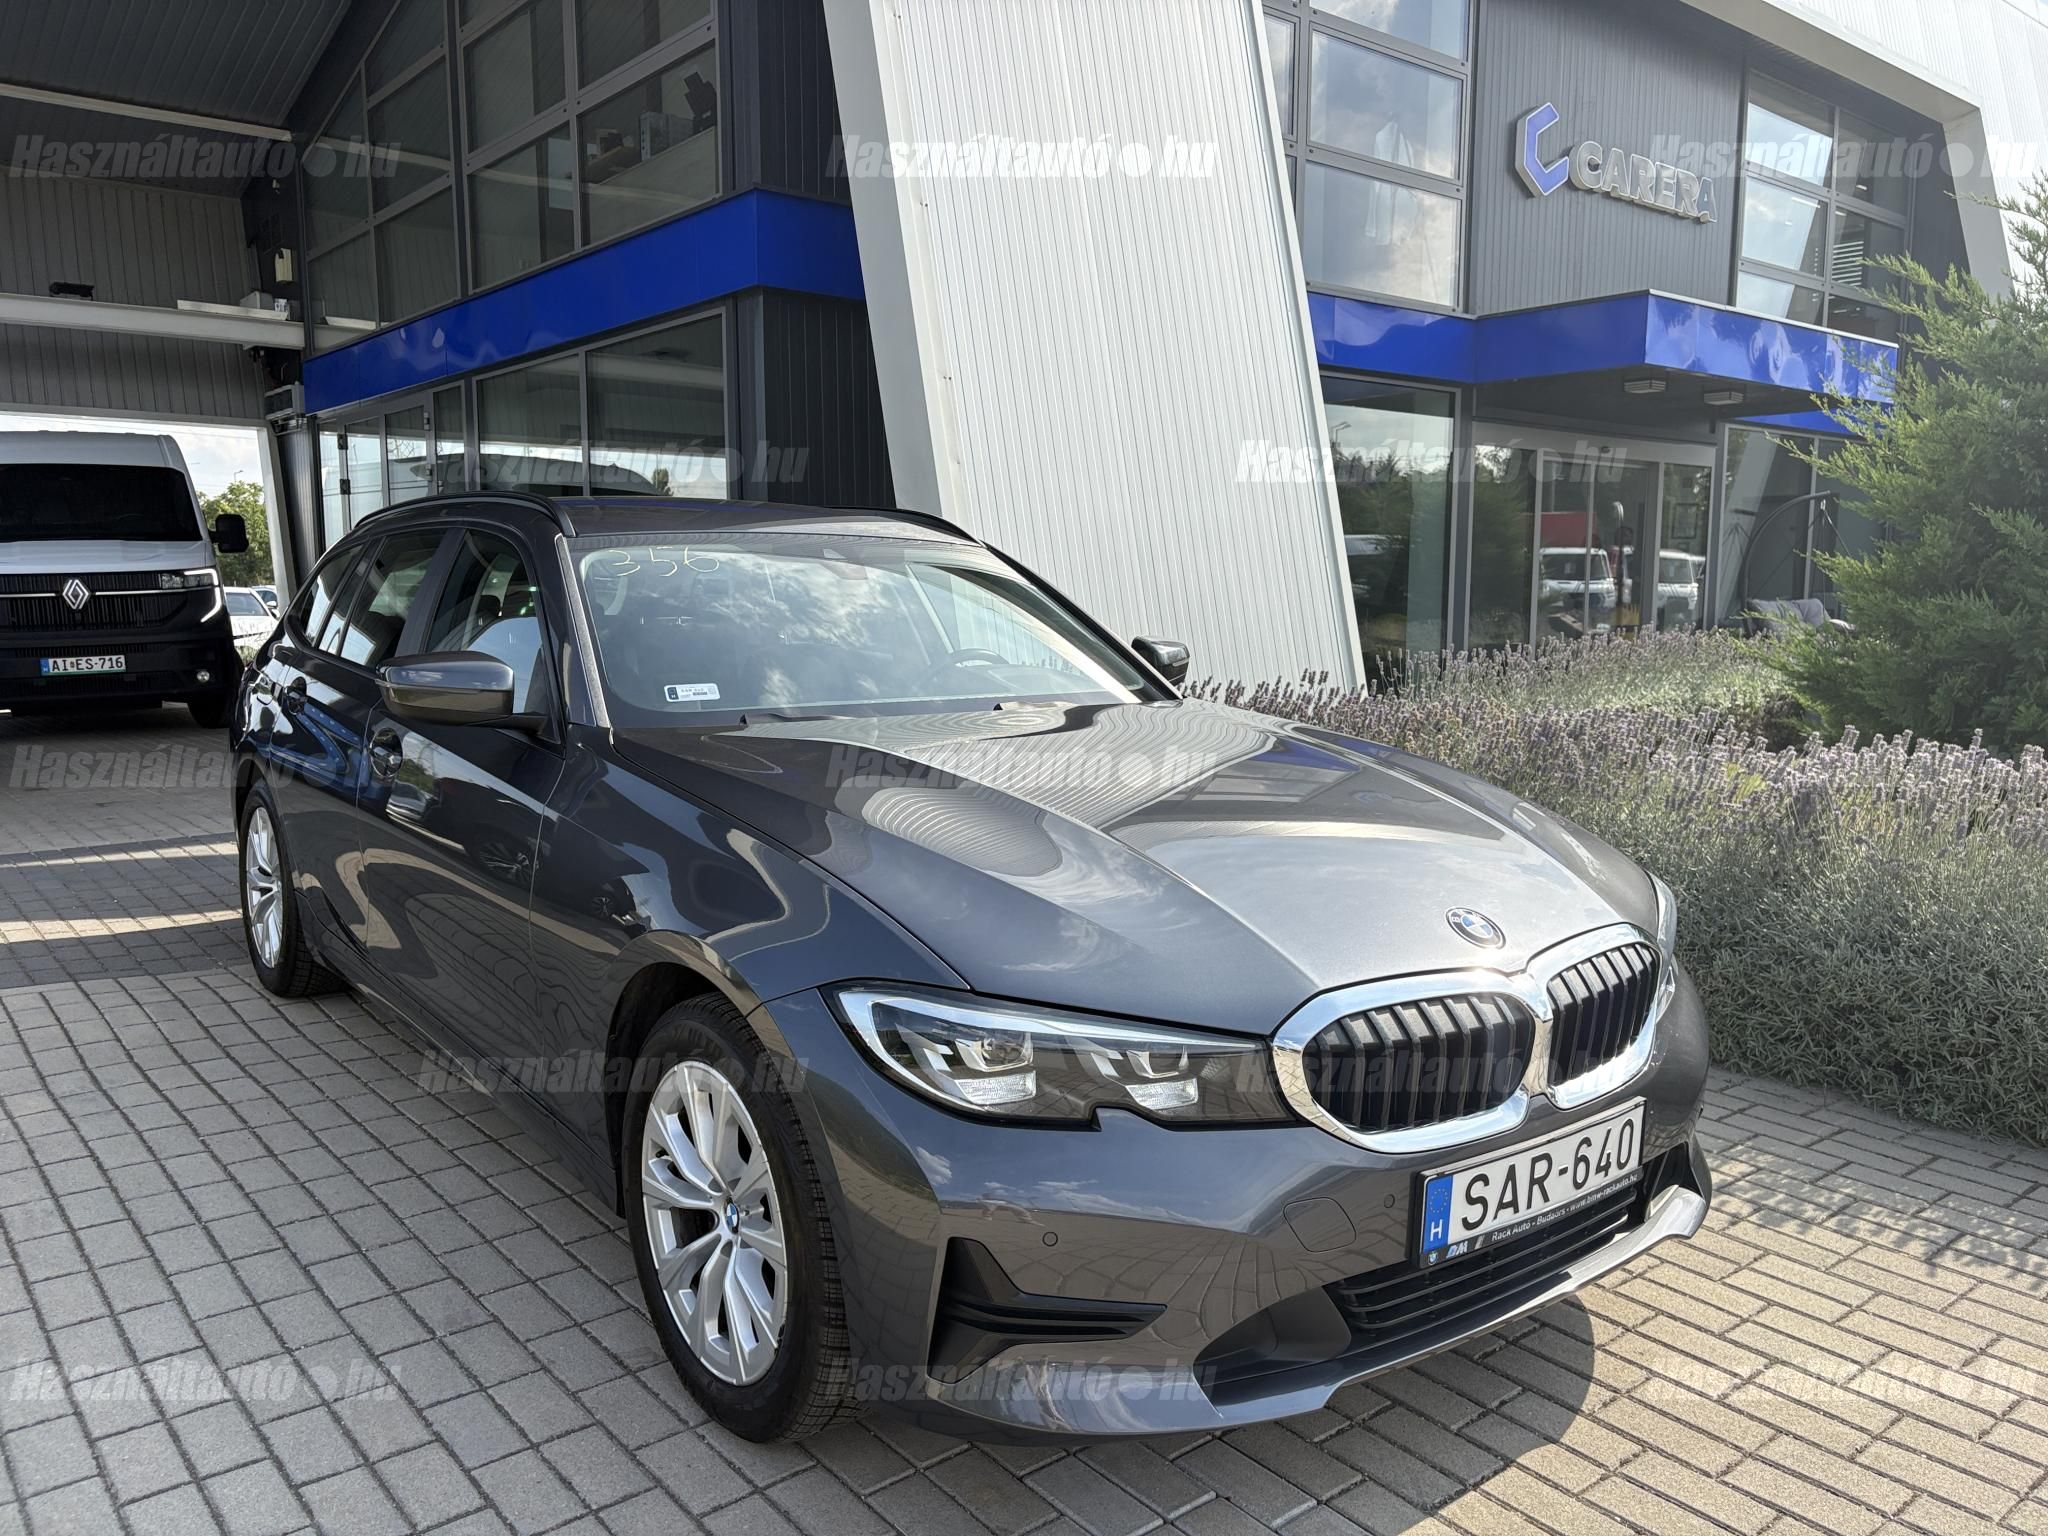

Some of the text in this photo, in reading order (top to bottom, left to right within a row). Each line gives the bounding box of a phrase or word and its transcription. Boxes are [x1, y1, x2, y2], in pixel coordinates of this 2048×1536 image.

[1569, 141, 1717, 222] CARERA
[608, 546, 720, 577] 356
[52, 659, 69, 672] AI
[1461, 1118, 1635, 1231] SAR-640
[1430, 1218, 1443, 1242] H
[1491, 1227, 1511, 1242] Rack
